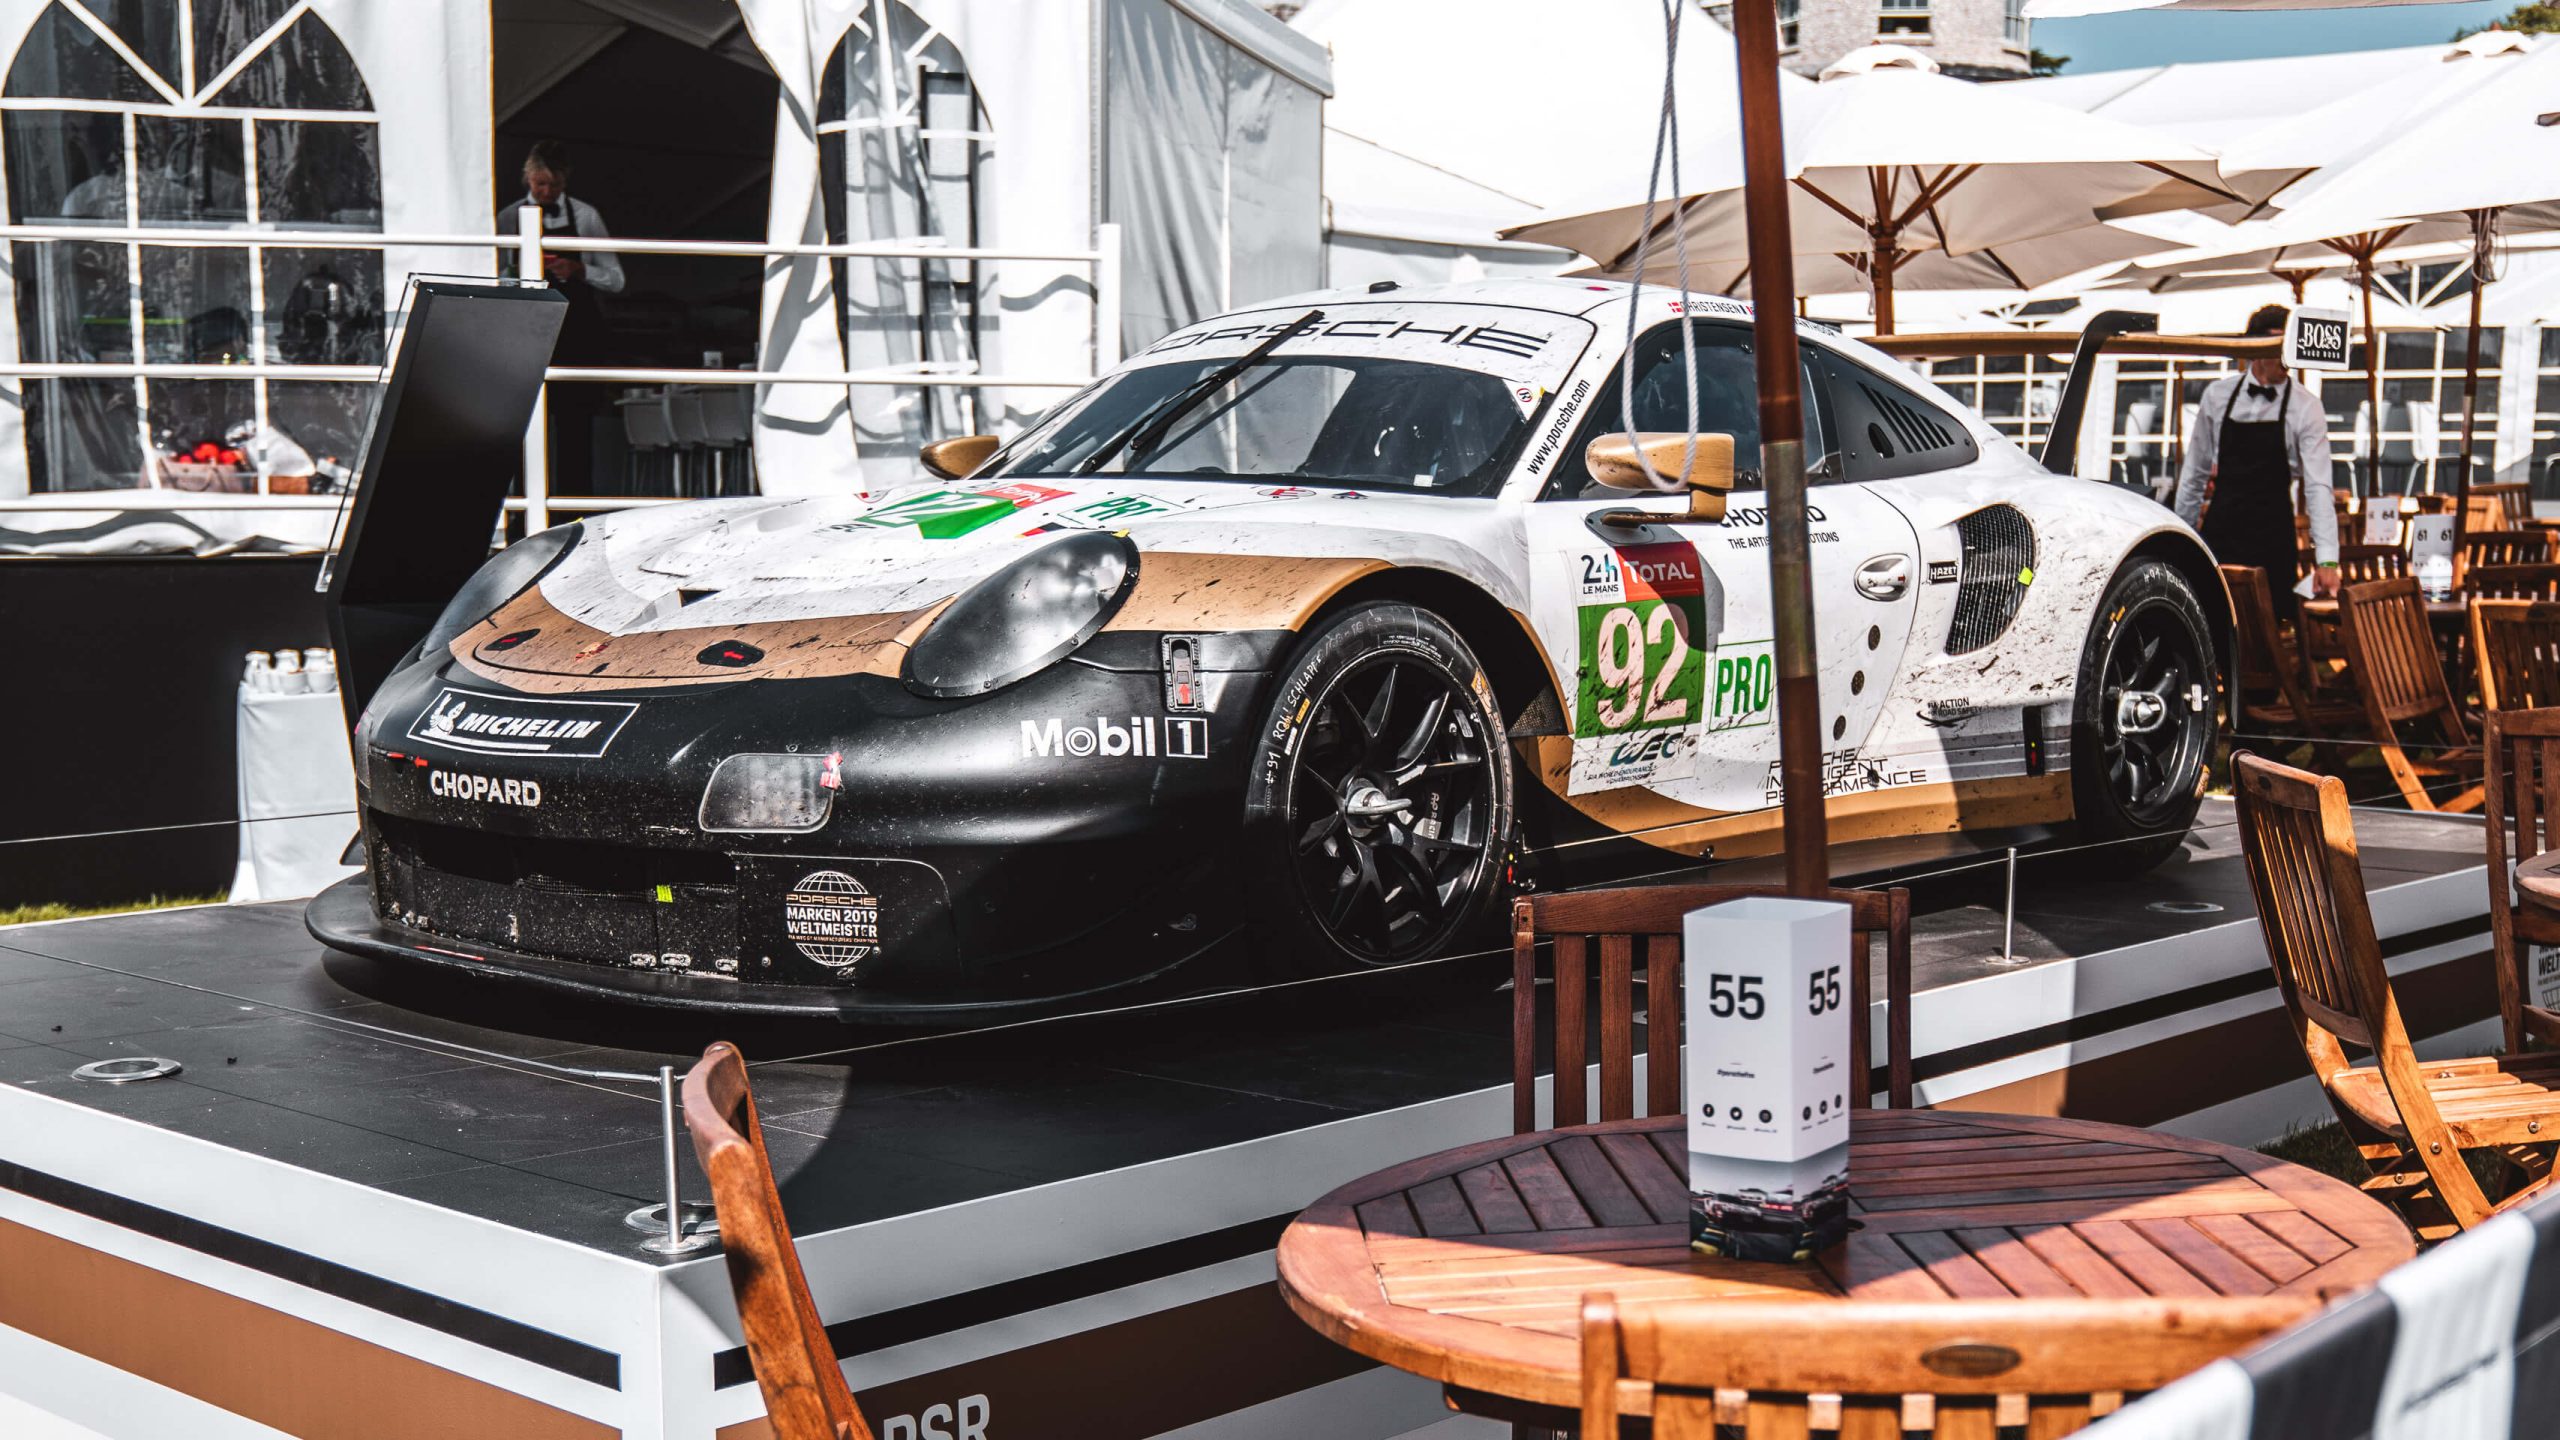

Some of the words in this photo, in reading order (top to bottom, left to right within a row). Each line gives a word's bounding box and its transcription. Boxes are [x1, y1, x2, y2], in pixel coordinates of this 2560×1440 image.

[1146, 320, 1549, 359] ORSCHE
[2303, 322, 2342, 350] BOSS
[1527, 379, 1591, 475] www.porsche.com
[1720, 506, 1827, 528] CHOD
[1728, 538, 1747, 549] THE
[1749, 536, 1769, 548] ARTIS
[1809, 531, 1840, 545] OTIONS
[2417, 530, 2427, 541] 61
[2441, 529, 2452, 541] 61
[1581, 553, 1618, 584] 24h
[1623, 560, 1696, 584] TOTAL
[1930, 564, 1958, 579] HAZET
[1583, 586, 1594, 595] LE
[1594, 584, 1619, 594] MANS
[1598, 603, 1689, 729] 92
[1714, 653, 1772, 718] PRO
[1940, 697, 1970, 709] ACTION
[1957, 706, 1982, 715] SAFETY
[456, 713, 602, 739] MICHELIN
[1020, 716, 1156, 757] Mobil
[1609, 732, 1685, 767] WEC
[1768, 748, 1855, 775] PCHE
[1766, 759, 1888, 790] INIGENT
[1766, 770, 1927, 805] PEORMANCE
[430, 770, 542, 807] CHOPARD
[786, 894, 877, 906] PORSCHE
[787, 907, 841, 922] MARKEN
[843, 910, 878, 923] 2019
[787, 921, 878, 938] WELTMEISTER
[1710, 973, 1766, 1021] 55
[1808, 965, 1841, 1016] 55
